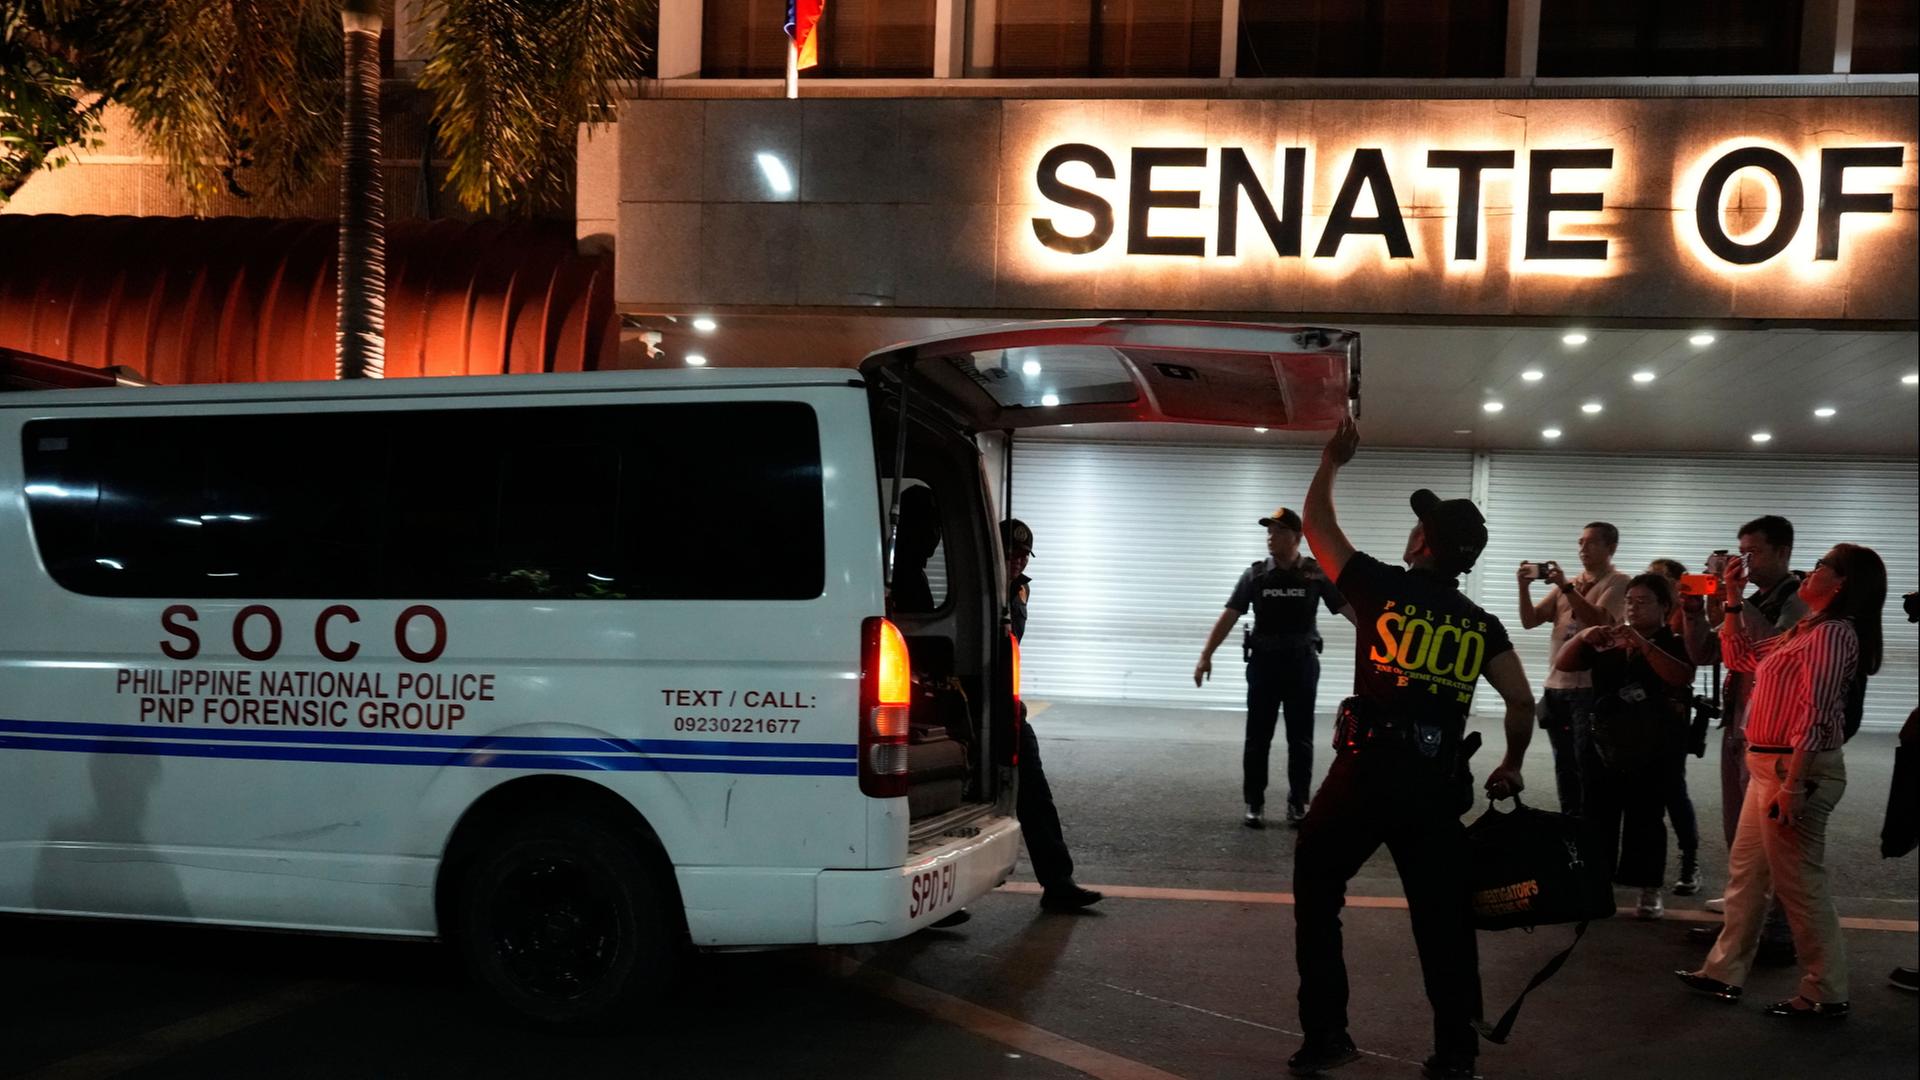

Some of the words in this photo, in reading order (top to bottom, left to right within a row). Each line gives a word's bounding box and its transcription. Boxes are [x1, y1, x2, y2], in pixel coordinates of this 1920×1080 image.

[1031, 143, 1614, 260] SENATE
[1696, 146, 1905, 264] OF
[1262, 588, 1306, 597] POLICE
[1384, 600, 1487, 632] POLICE
[159, 604, 448, 663] SOCO
[1370, 612, 1485, 682] SOCO
[116, 668, 252, 696] PHILIPPINE
[259, 670, 389, 699] NATIONAL
[397, 672, 496, 702] POLICE
[1396, 675, 1472, 704] EAM
[1404, 670, 1431, 682] CRIME
[139, 697, 195, 724] PNP
[203, 697, 348, 727] FORENSIC
[358, 701, 466, 731] GROUP
[661, 689, 723, 707] TEXT
[729, 690, 737, 707] /
[743, 691, 816, 709] CALL:
[674, 717, 801, 734] 09230221677
[909, 870, 939, 919] SPD
